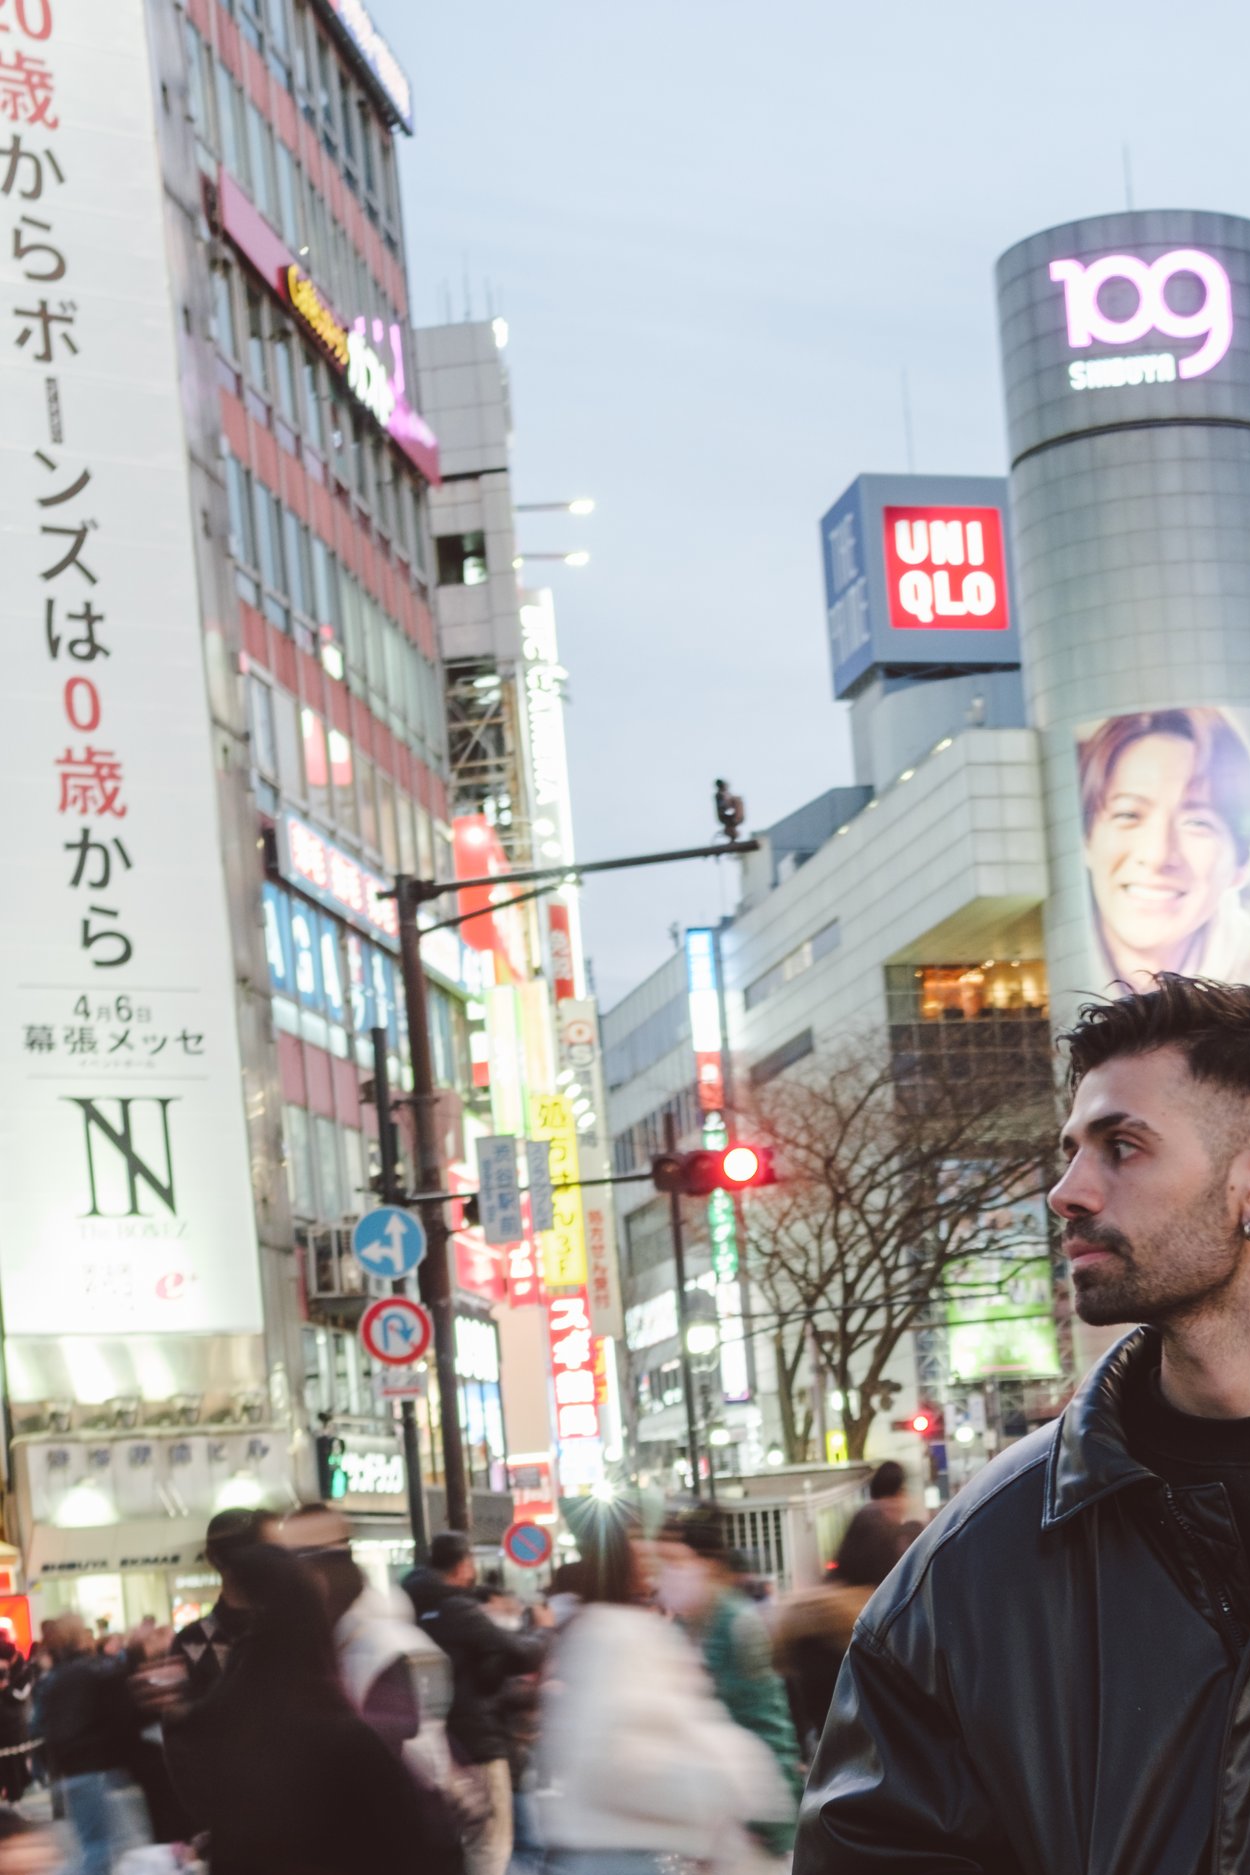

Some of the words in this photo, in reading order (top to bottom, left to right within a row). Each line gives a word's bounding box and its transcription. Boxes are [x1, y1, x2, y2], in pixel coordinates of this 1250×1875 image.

[1049, 249, 1233, 379] 109
[1068, 353, 1176, 391] SHIBUYA
[0, 0, 133, 968] 0歳からボーンズは0歳から
[895, 519, 985, 567] UNI
[899, 570, 996, 623] QLO
[72, 994, 152, 1024] 4月6日
[23, 1024, 205, 1056] 幕張メッセ
